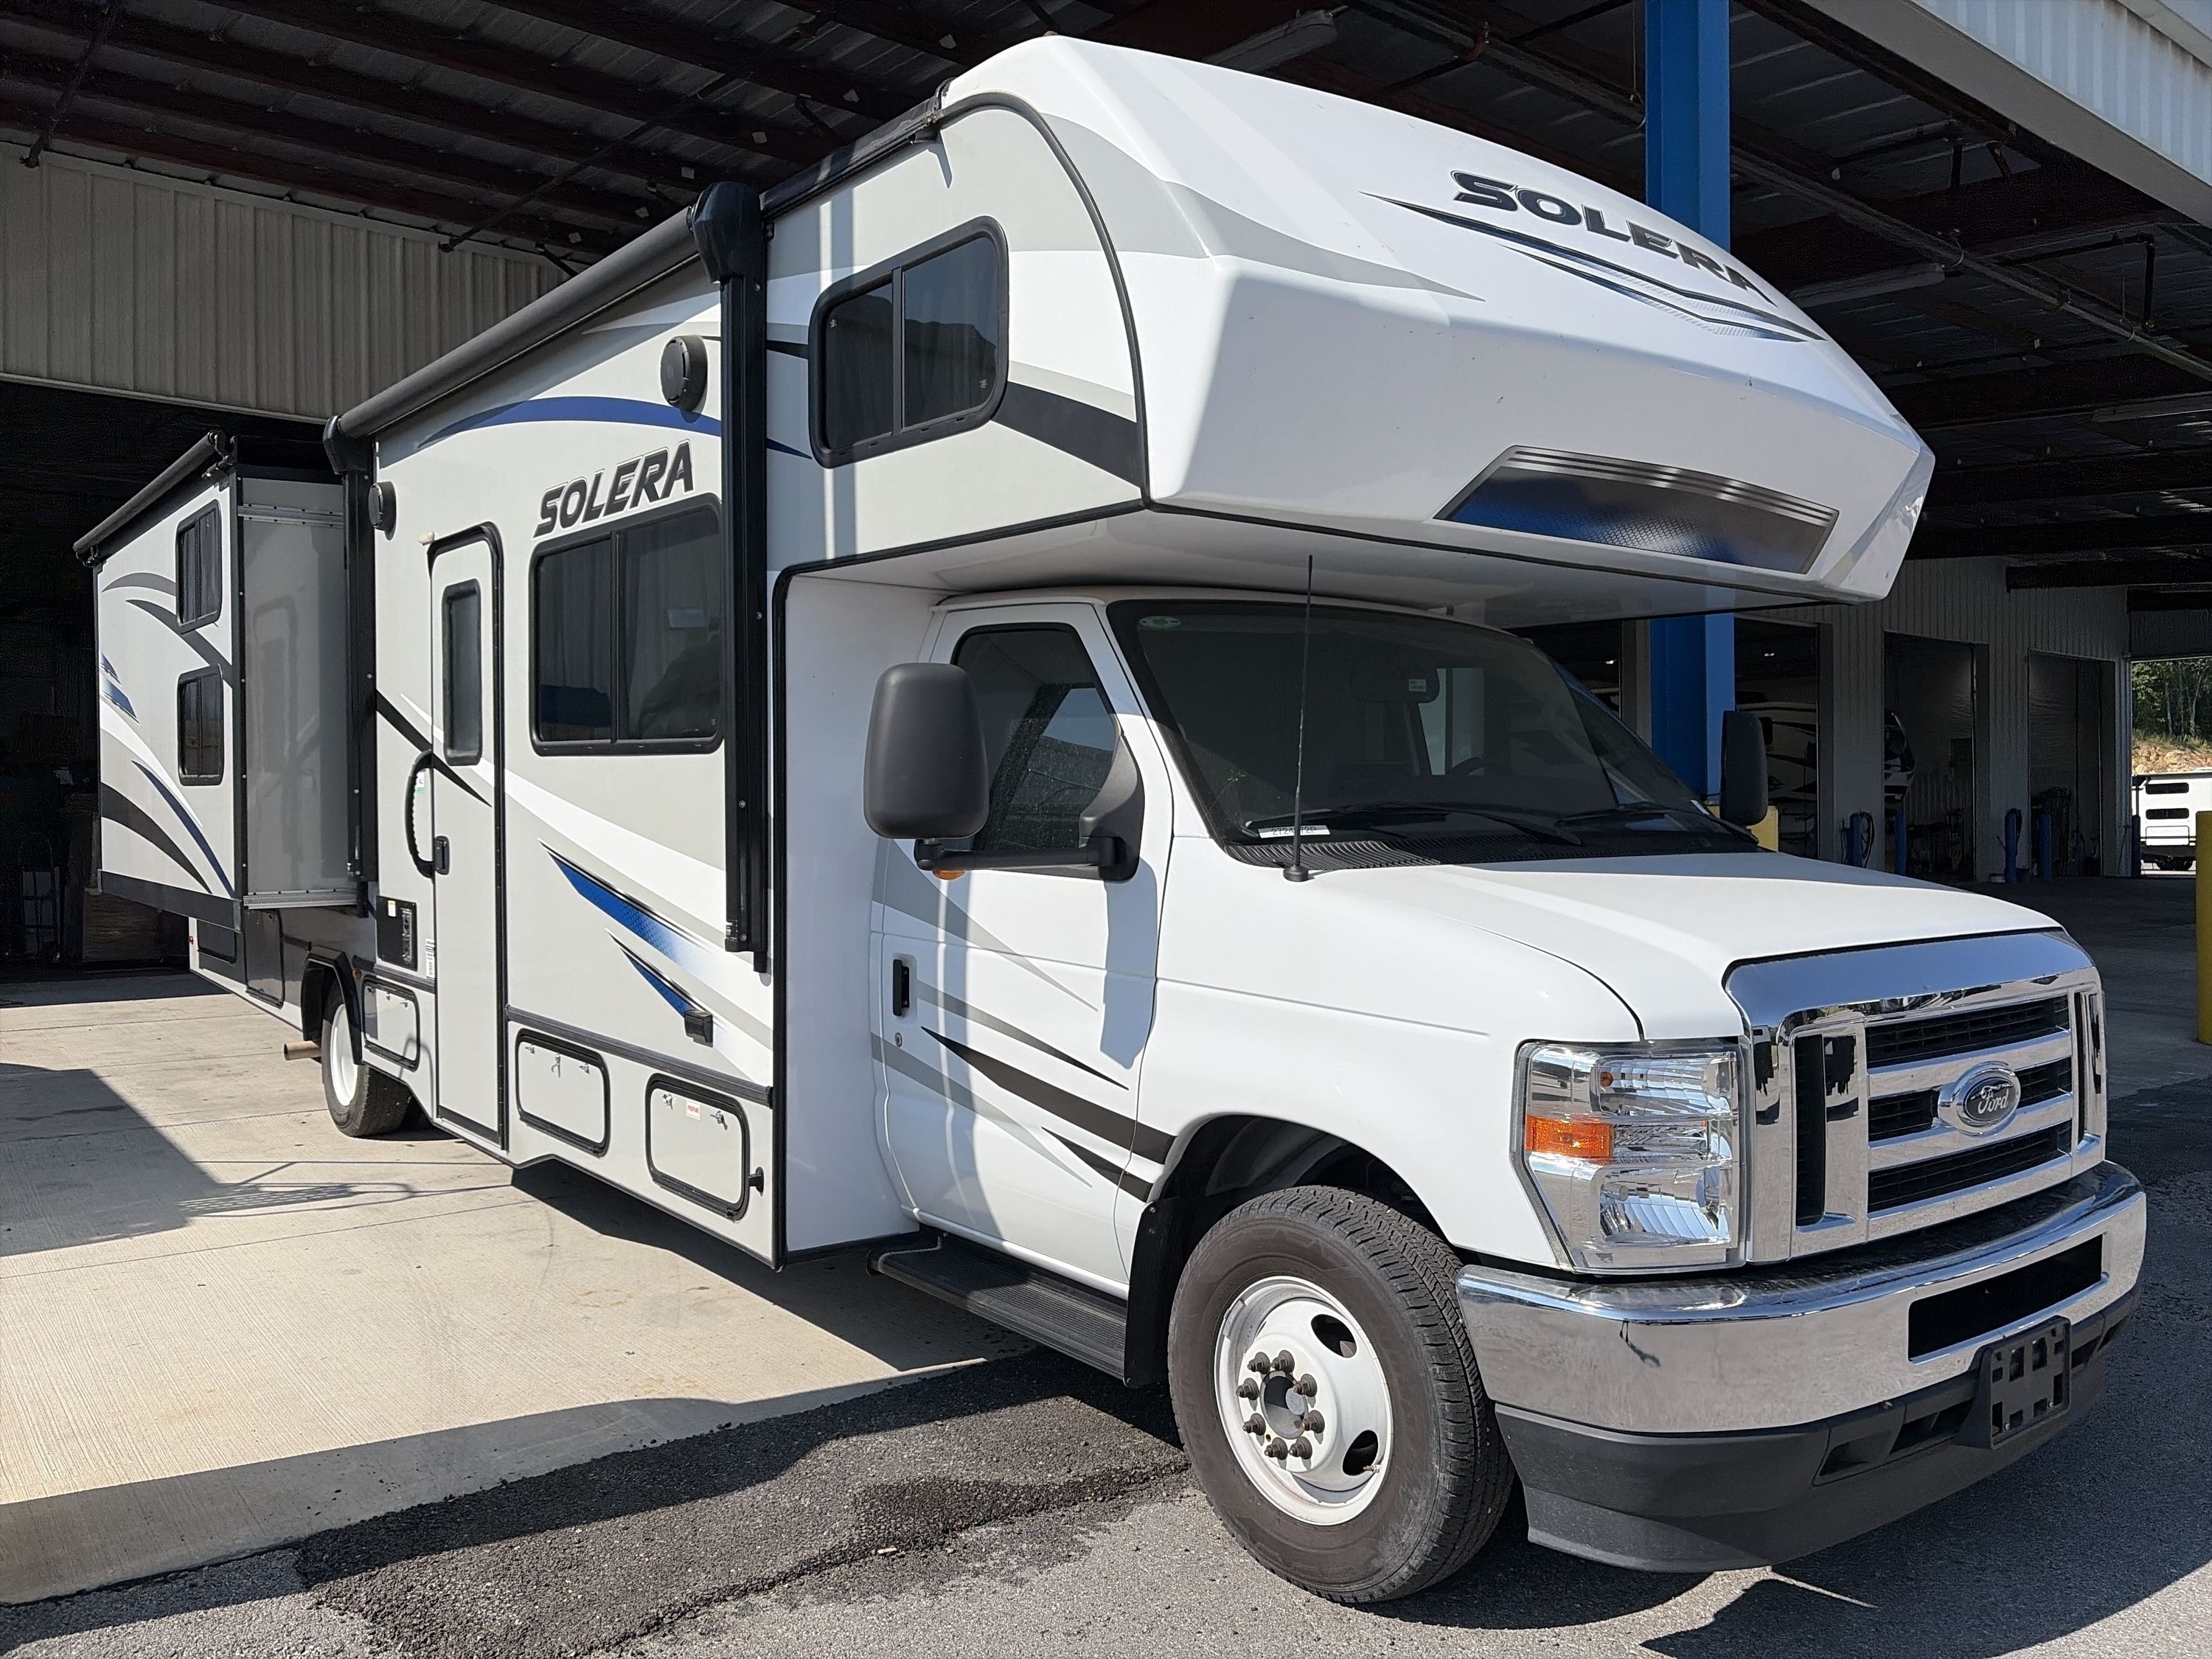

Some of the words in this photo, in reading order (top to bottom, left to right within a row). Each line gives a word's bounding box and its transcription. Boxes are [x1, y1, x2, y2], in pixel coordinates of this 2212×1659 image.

[1450, 170, 1777, 307] SOLERA
[532, 439, 695, 539] SOLERA
[1970, 1082, 2014, 1114] Ford
